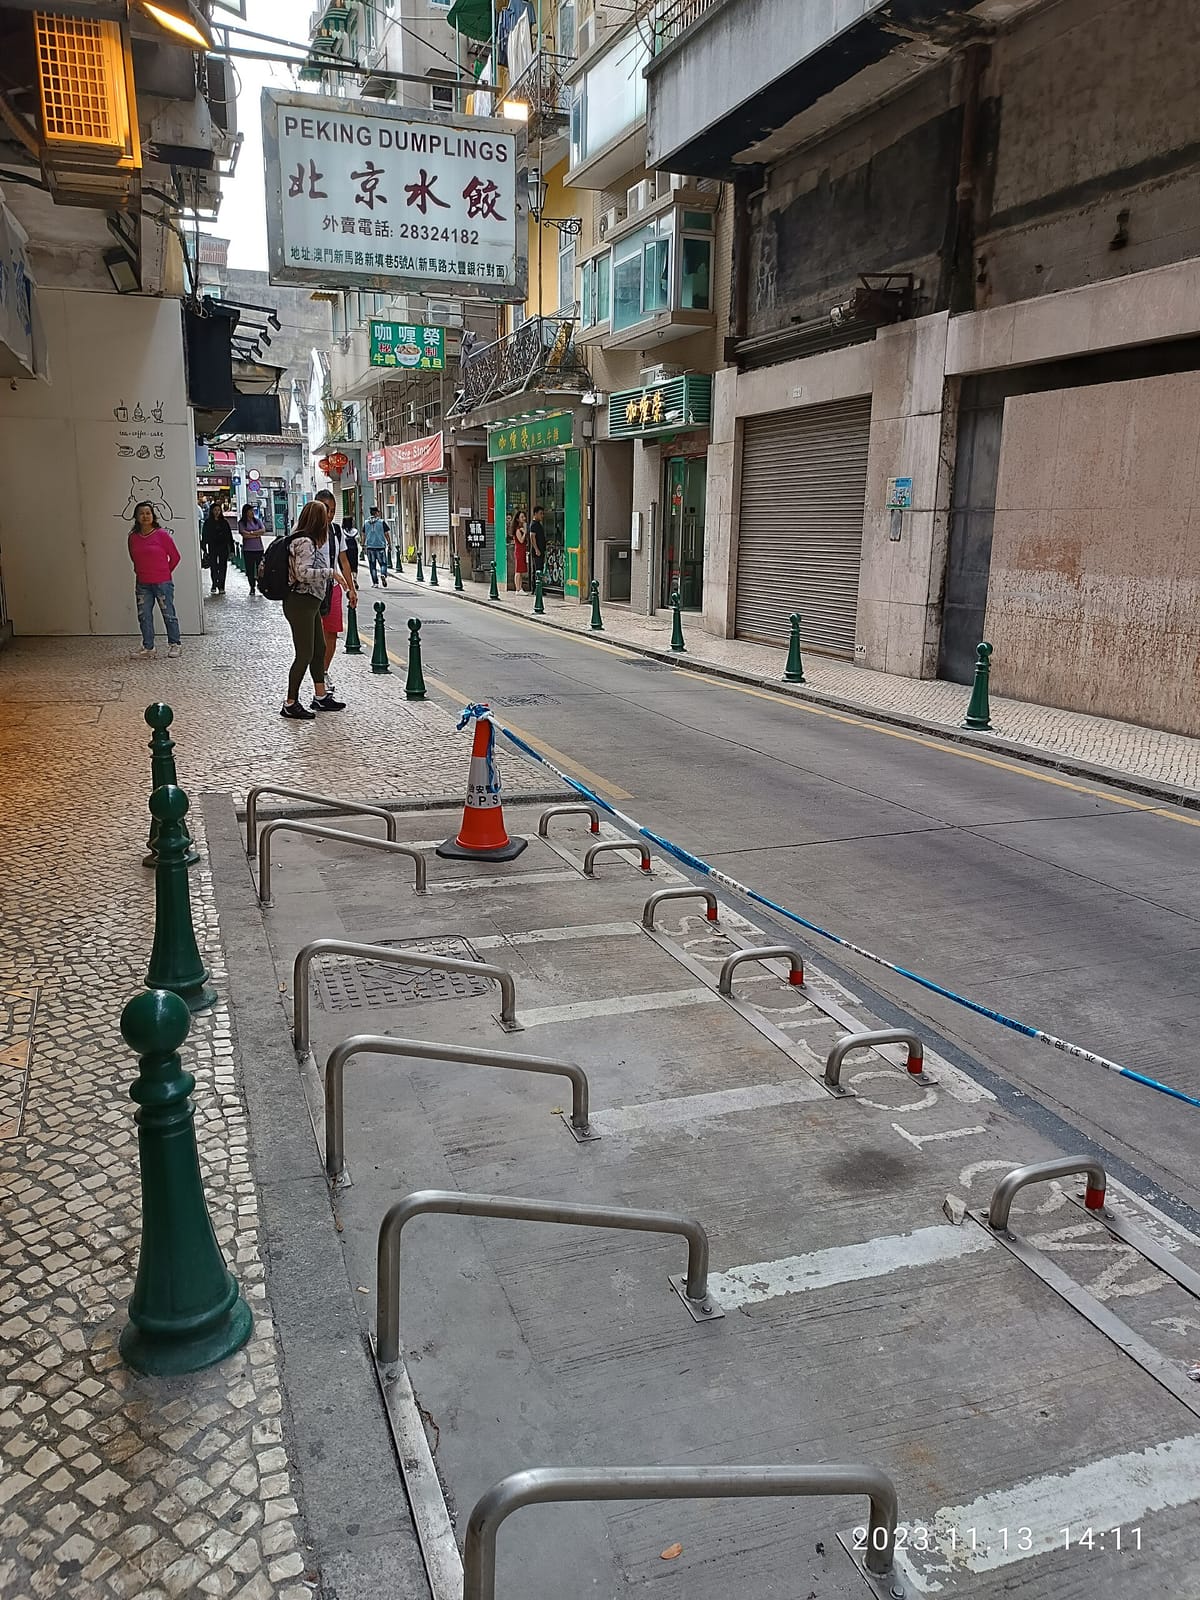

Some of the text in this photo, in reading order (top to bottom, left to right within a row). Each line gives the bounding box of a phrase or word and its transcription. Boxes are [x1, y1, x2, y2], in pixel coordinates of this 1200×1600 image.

[285, 116, 508, 163] PEKING DUMPLINGS
[288, 158, 508, 222] 北京水餃
[399, 223, 479, 245] 28324182
